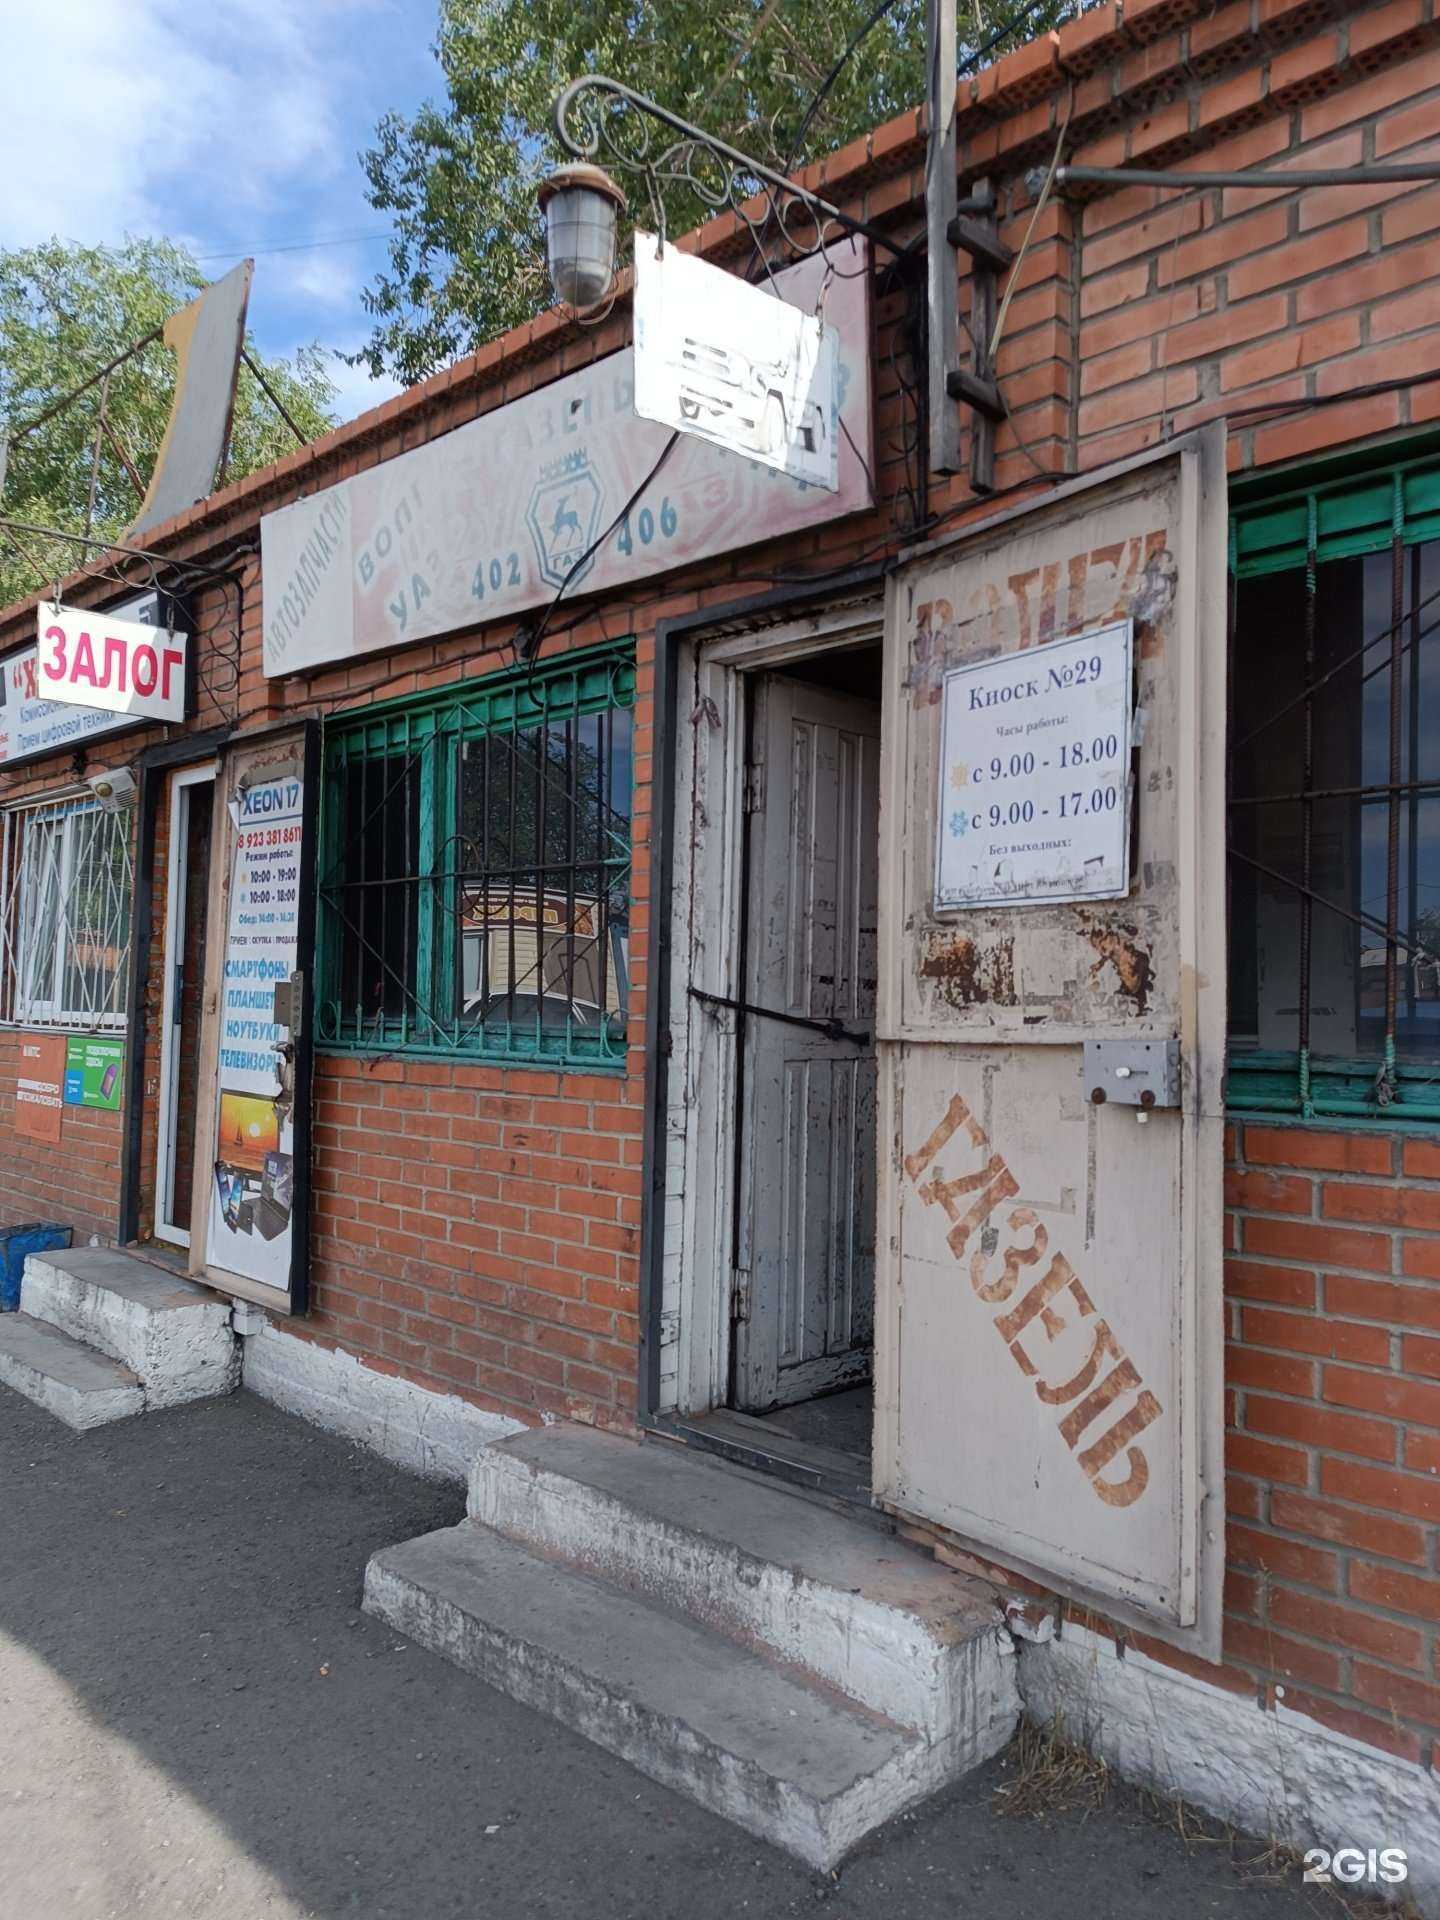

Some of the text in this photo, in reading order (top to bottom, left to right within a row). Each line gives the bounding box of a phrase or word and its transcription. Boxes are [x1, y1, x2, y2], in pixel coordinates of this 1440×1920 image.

[617, 496, 677, 556] 406
[472, 552, 521, 600] 402
[43, 625, 184, 700] ЗАЛОГ
[967, 656, 1102, 712] Киоск №29
[996, 714, 1069, 738] Часы работы:
[990, 752, 1034, 781] 9.00
[1059, 734, 1117, 768] 18.00
[243, 783, 299, 816] XEON 17
[989, 800, 1034, 827] 9.00
[1059, 786, 1116, 818] 17.00
[247, 830, 264, 848] 923
[266, 828, 282, 846] 381
[283, 826, 302, 843] 8611
[989, 843, 1008, 856] Без
[246, 851, 267, 862] Режим
[250, 870, 271, 883] 10:00
[278, 867, 296, 882] 19:00
[249, 890, 271, 904] 10:00
[277, 888, 296, 903] 18:00
[225, 958, 289, 982] СМАРТФОНЫ
[226, 1019, 280, 1041] НОУТБУКИ
[904, 1092, 1164, 1508] ГАЗЕЛЬ
